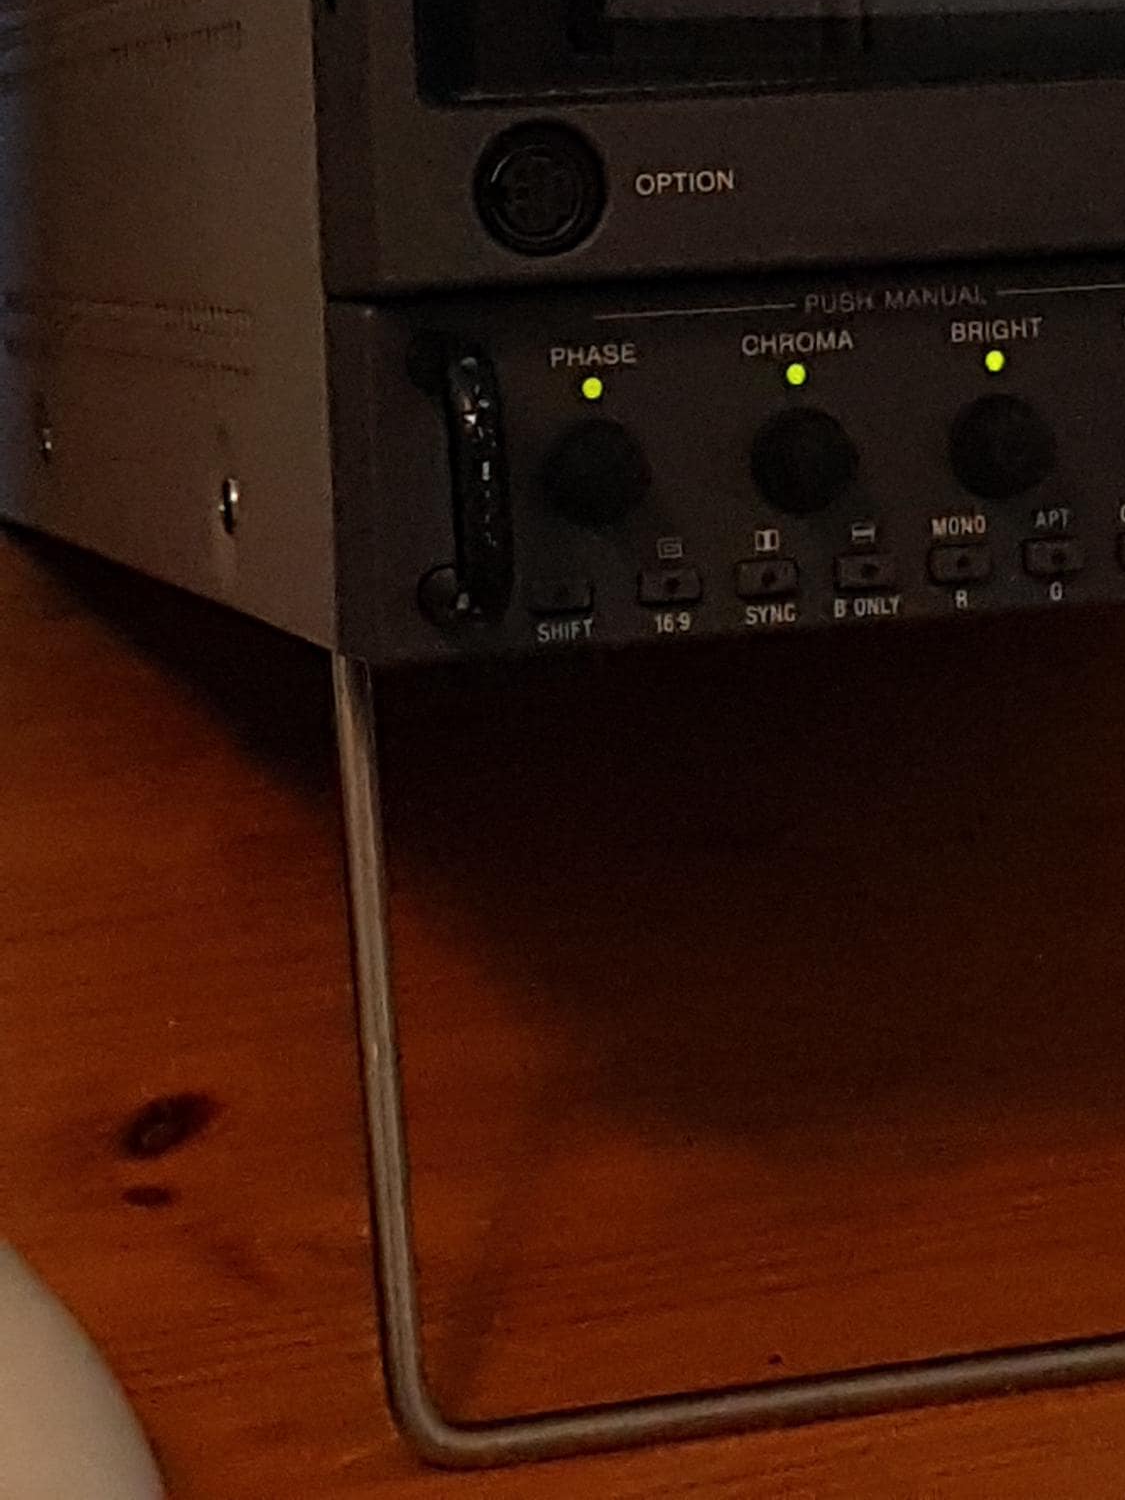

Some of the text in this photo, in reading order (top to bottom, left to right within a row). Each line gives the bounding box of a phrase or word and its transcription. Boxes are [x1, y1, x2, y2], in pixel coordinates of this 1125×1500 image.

[634, 169, 736, 197] OPTION
[804, 284, 987, 315] PUSH MANUAL
[950, 316, 1043, 344] BRIGHT
[550, 343, 637, 368] PHASE
[742, 330, 854, 358] CHROMA
[931, 514, 987, 537] MONO
[1034, 507, 1069, 529] APT
[745, 603, 796, 626] SYNC
[833, 594, 900, 619] B ONLY
[536, 618, 593, 644] SHIFT
